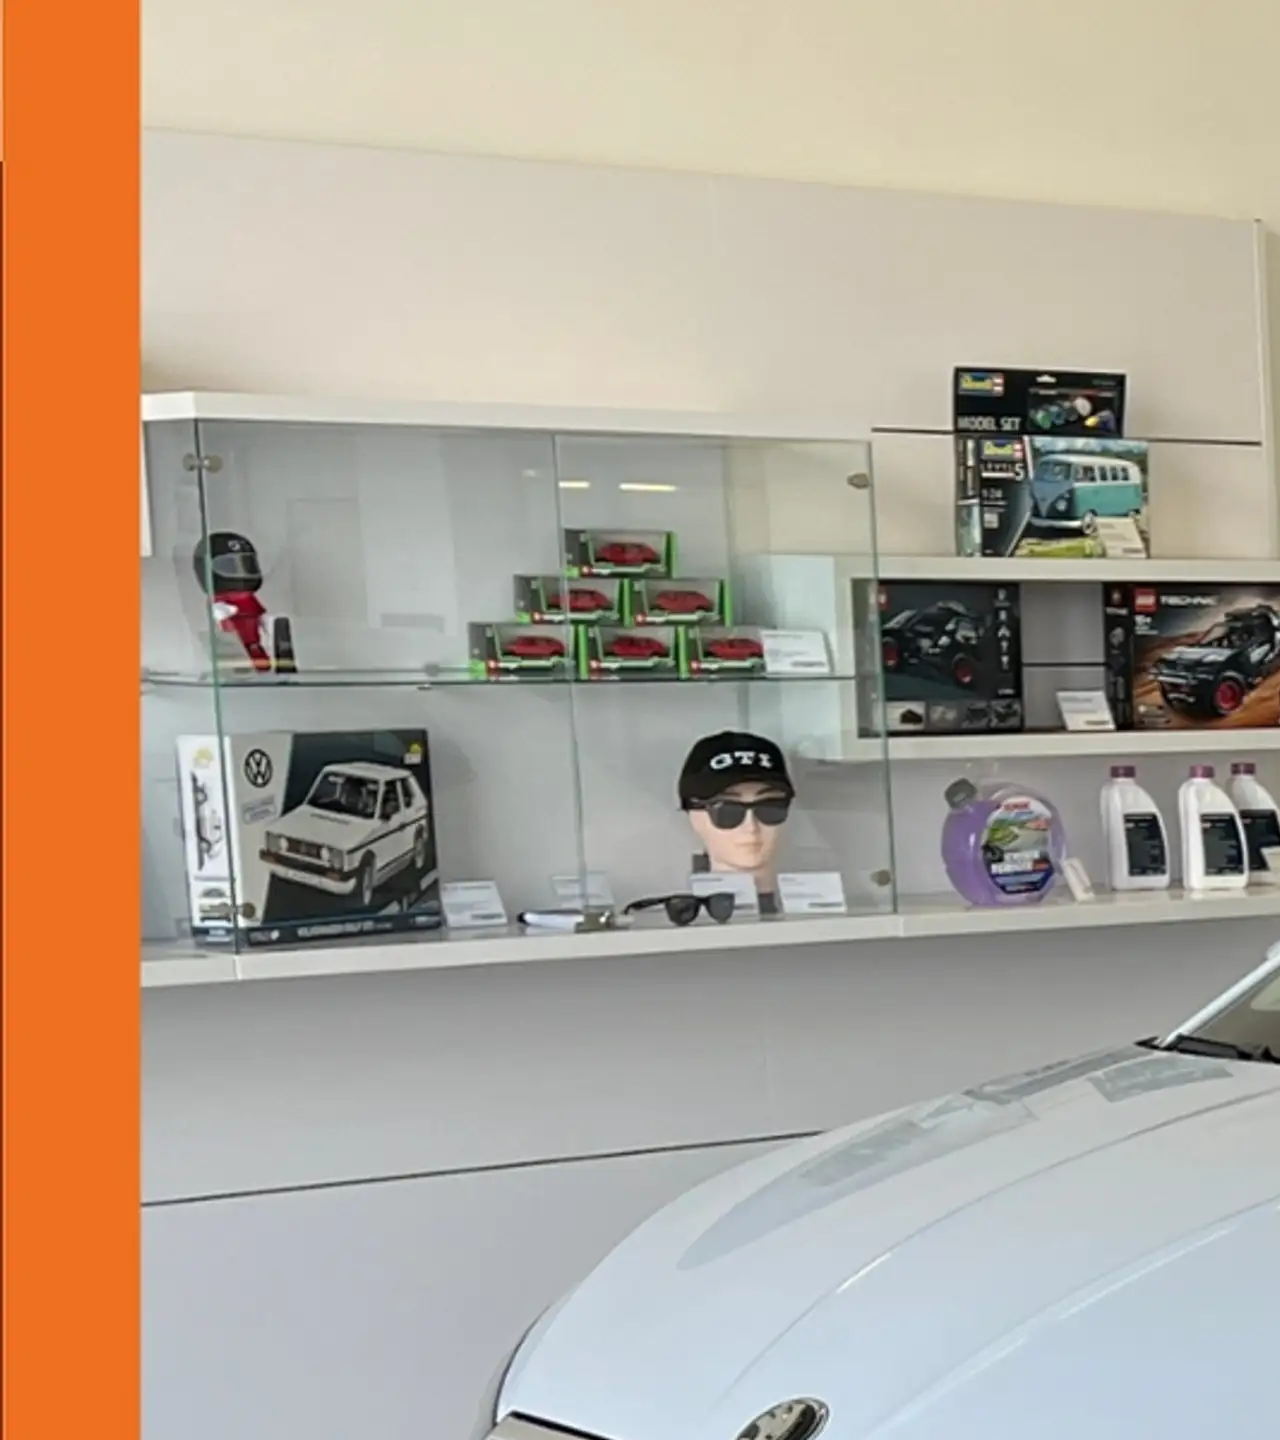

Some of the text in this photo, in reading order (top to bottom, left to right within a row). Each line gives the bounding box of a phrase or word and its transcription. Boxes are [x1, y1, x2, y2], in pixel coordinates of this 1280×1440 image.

[1001, 416, 1021, 431] SET
[1015, 463, 1025, 481] 5
[709, 750, 773, 770] GTI
